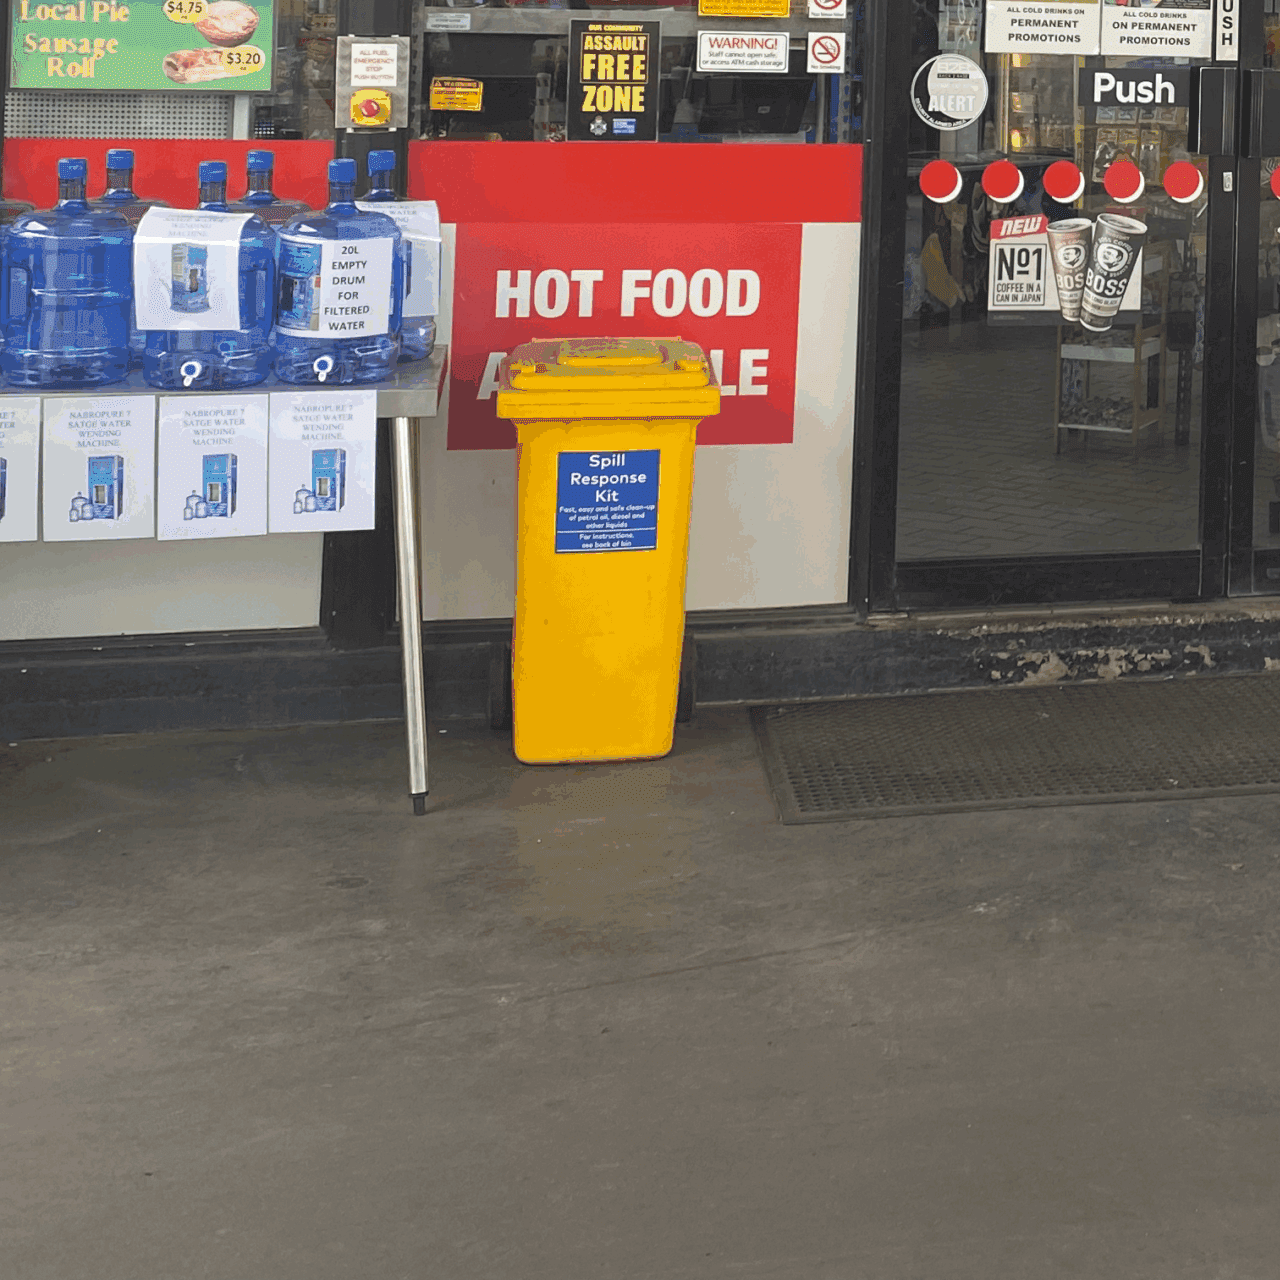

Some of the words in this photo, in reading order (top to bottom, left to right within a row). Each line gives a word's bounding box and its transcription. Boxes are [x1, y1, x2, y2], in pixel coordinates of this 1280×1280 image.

[20, 0, 86, 22] Local
[92, 0, 130, 22] Pie
[167, 1, 203, 14] $4.75
[1011, 19, 1079, 28] PERMANENT
[1112, 21, 1128, 29] ON
[1131, 22, 1198, 31] PERMANENT
[584, 35, 647, 51] ASSAULT
[709, 37, 778, 50] WARNING!
[1008, 33, 1081, 43] PROMOTIONS
[1119, 36, 1190, 46] PROMOTIONS
[24, 33, 119, 60] Sausage
[226, 52, 261, 65] $3.20
[47, 57, 97, 78] Roll
[583, 54, 646, 80] FREE
[1093, 72, 1175, 104] Push
[582, 85, 645, 112] ZONE
[928, 95, 976, 112] ALERT
[1000, 217, 1042, 236] NEW
[342, 246, 359, 255] 20L
[332, 261, 367, 270] EMPTY
[332, 276, 365, 285] DRUM
[1086, 268, 1128, 296] BOSS
[495, 269, 603, 318] HOT
[621, 268, 761, 317] FOOD
[997, 282, 1024, 293] COFFEE
[1026, 283, 1035, 293] IN
[1036, 283, 1041, 293] A
[338, 292, 359, 300] FOR
[996, 293, 1010, 302] CAN
[1012, 294, 1018, 302] IN
[1020, 294, 1041, 302] JAPAN
[324, 306, 370, 315] FILTERED
[328, 321, 365, 331] WATER
[100, 420, 132, 428] WATER
[214, 418, 245, 426] WATER
[77, 439, 119, 447] MACHINE
[589, 453, 625, 470] Spill
[571, 472, 647, 487] Response
[595, 489, 619, 502] Kit
[578, 506, 594, 514] easy
[578, 513, 598, 522] petrol
